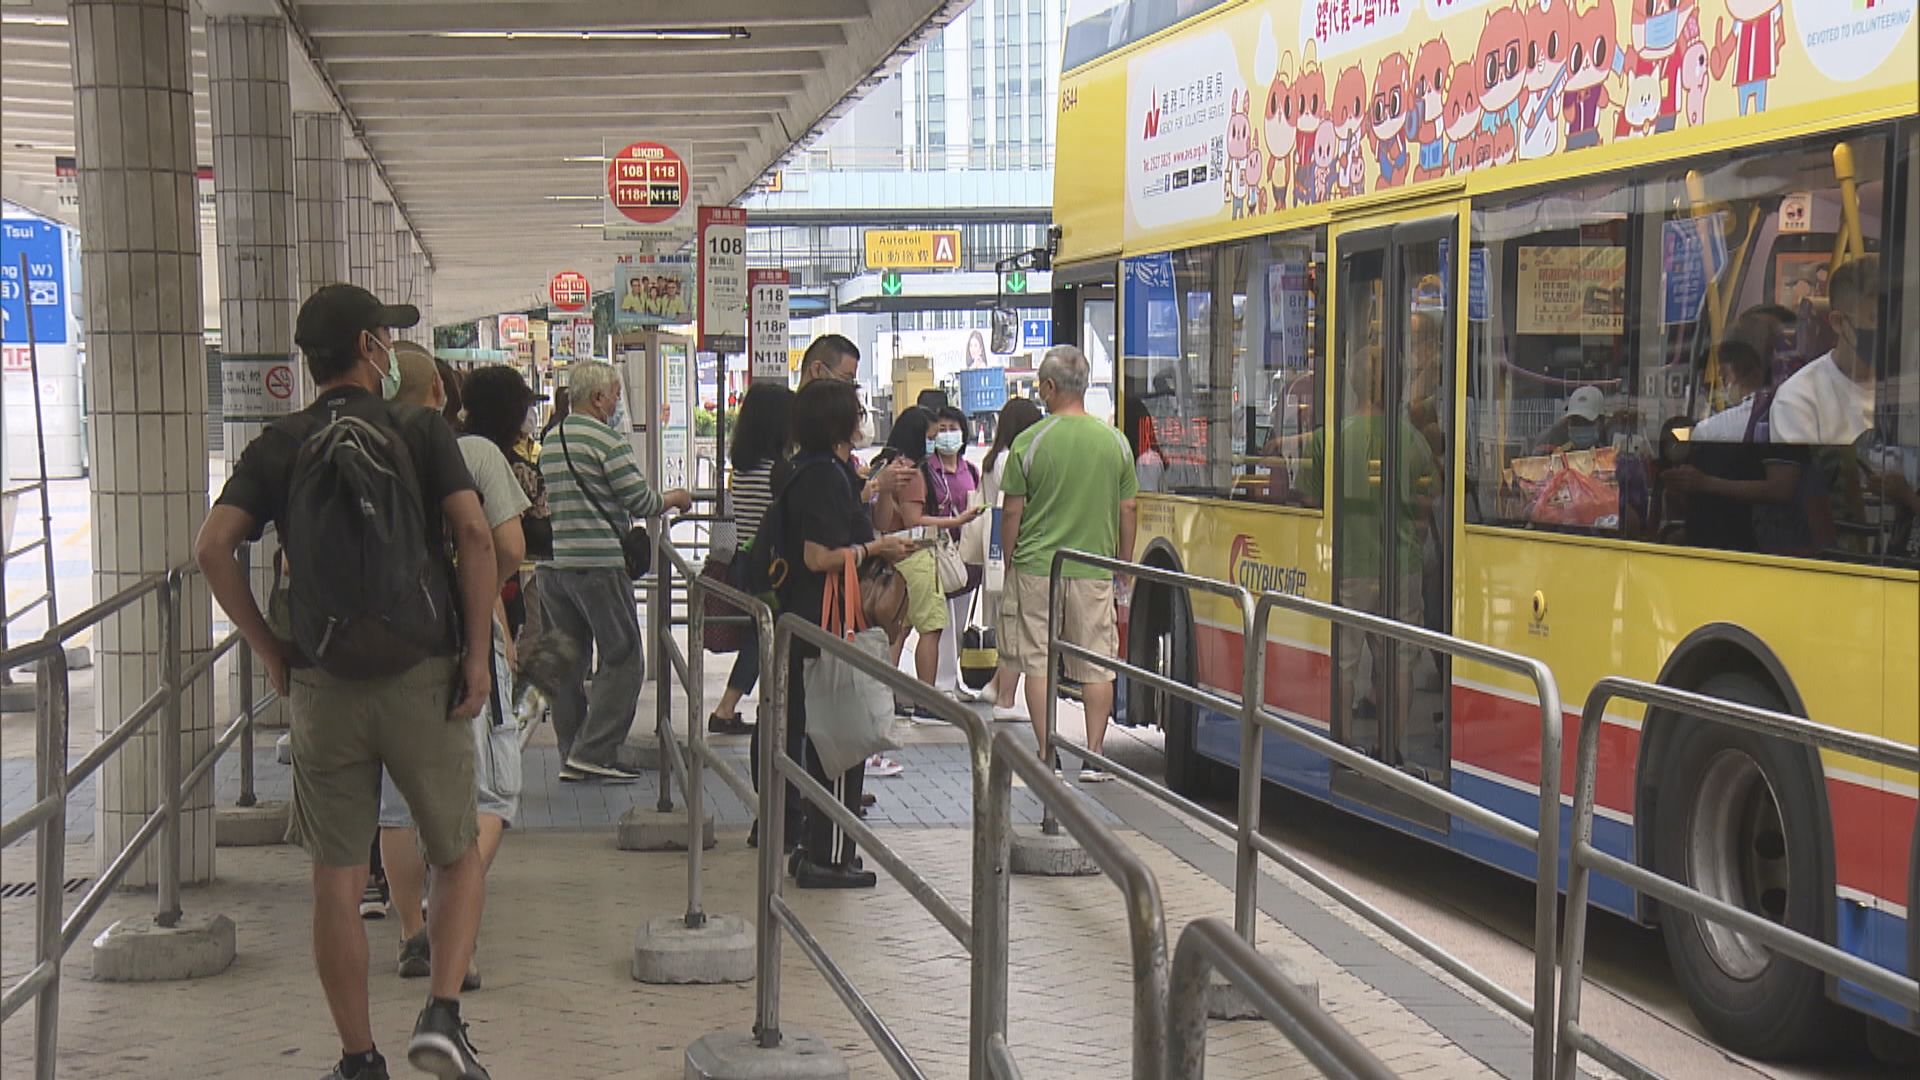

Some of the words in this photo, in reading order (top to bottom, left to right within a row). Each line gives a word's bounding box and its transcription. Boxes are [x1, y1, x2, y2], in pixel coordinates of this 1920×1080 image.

[1807, 26, 1840, 47] DEVOTED
[1841, 24, 1850, 38] TO
[1852, 9, 1911, 37] VOLUNTEERING
[621, 163, 644, 178] 108
[654, 165, 676, 178] 118
[619, 187, 647, 201] 118P
[650, 188, 679, 201] N118
[4, 224, 34, 238] Tsui
[708, 236, 743, 256] 108
[880, 236, 921, 247] Autotoll
[757, 287, 784, 302] 118
[754, 319, 786, 333] 118P
[754, 350, 787, 364] N118
[1239, 559, 1284, 593] CITYBUS
